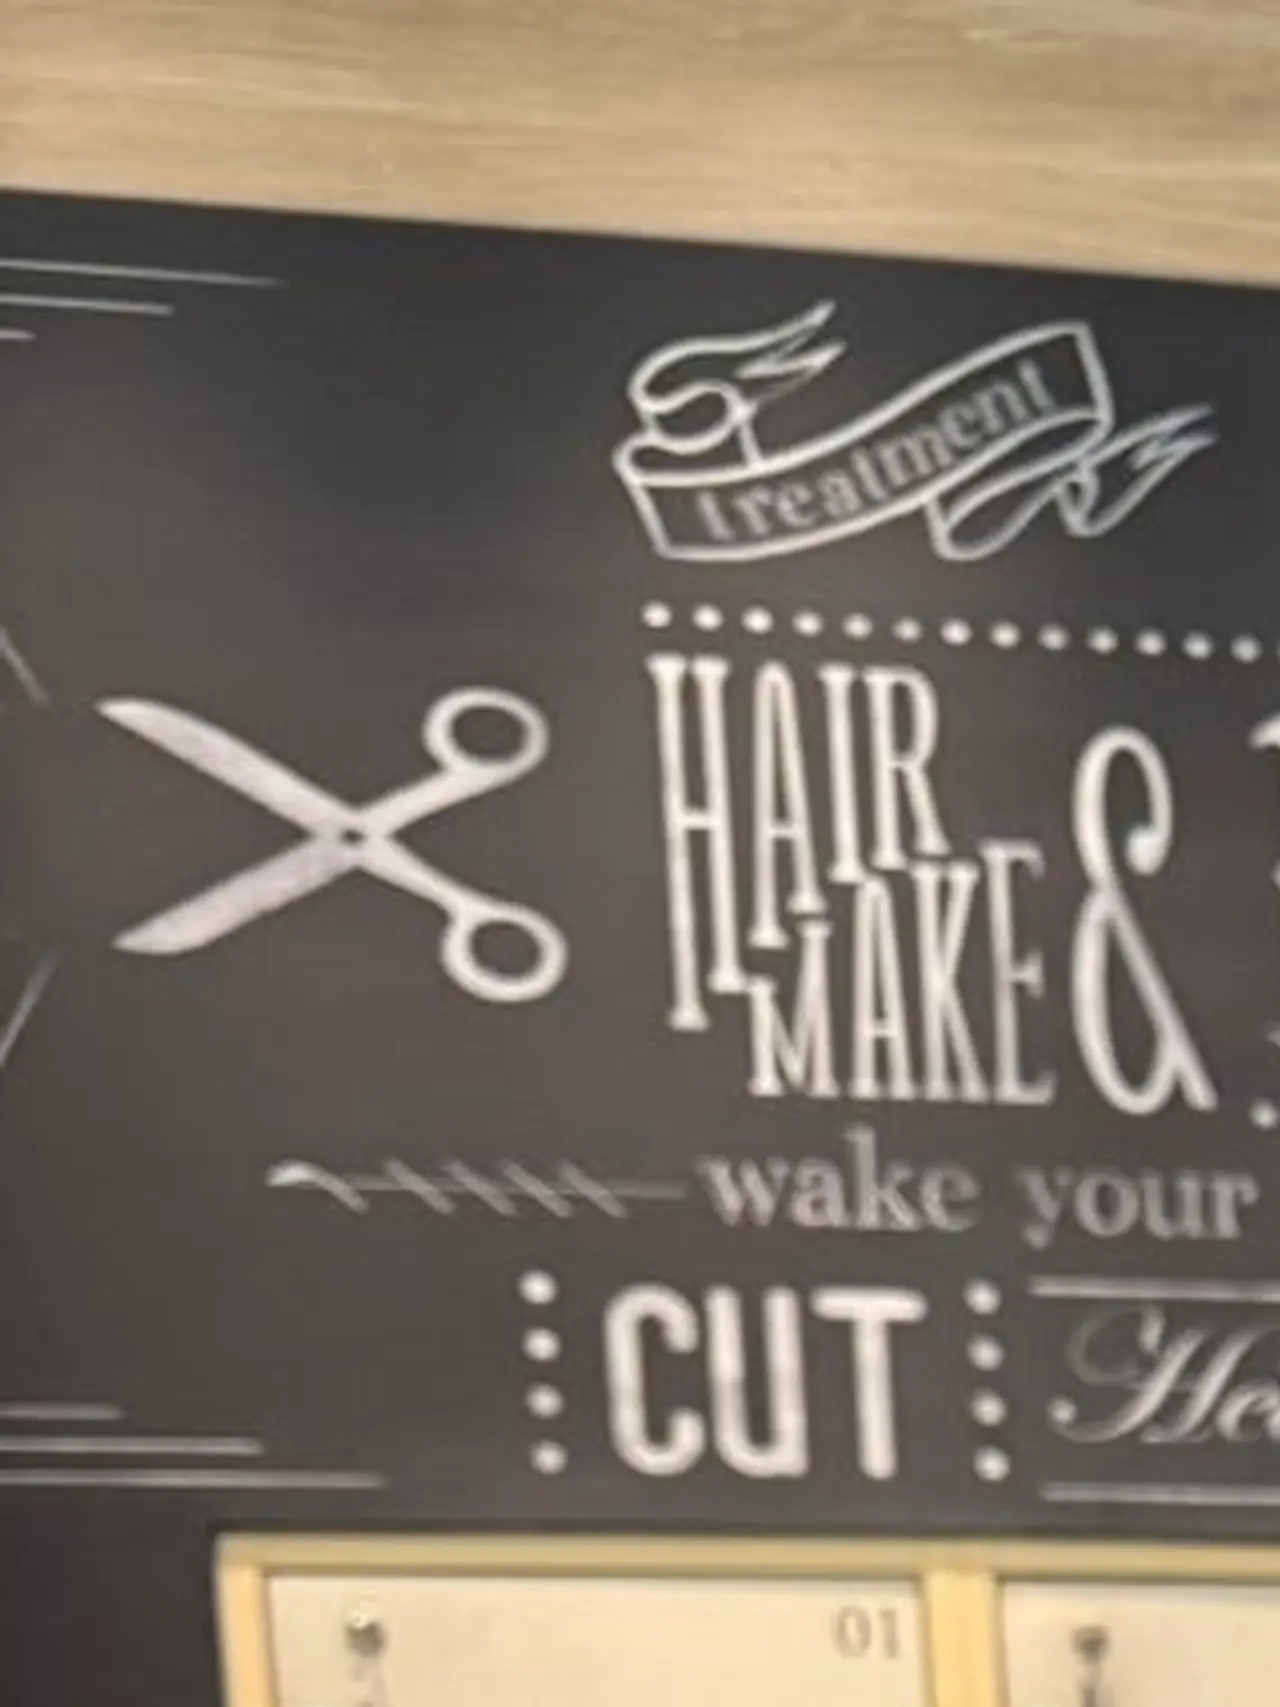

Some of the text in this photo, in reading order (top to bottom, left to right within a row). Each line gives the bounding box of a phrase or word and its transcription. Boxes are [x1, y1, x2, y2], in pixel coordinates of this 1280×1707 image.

[695, 358, 1056, 541] treatment
[645, 653, 950, 1032] HAIR
[1070, 724, 1219, 1116] &
[748, 836, 1056, 1106] MAKE
[698, 1122, 980, 1232] wake
[1012, 1163, 1260, 1249] your
[605, 1283, 928, 1481] CUT
[830, 1605, 903, 1660] 01
